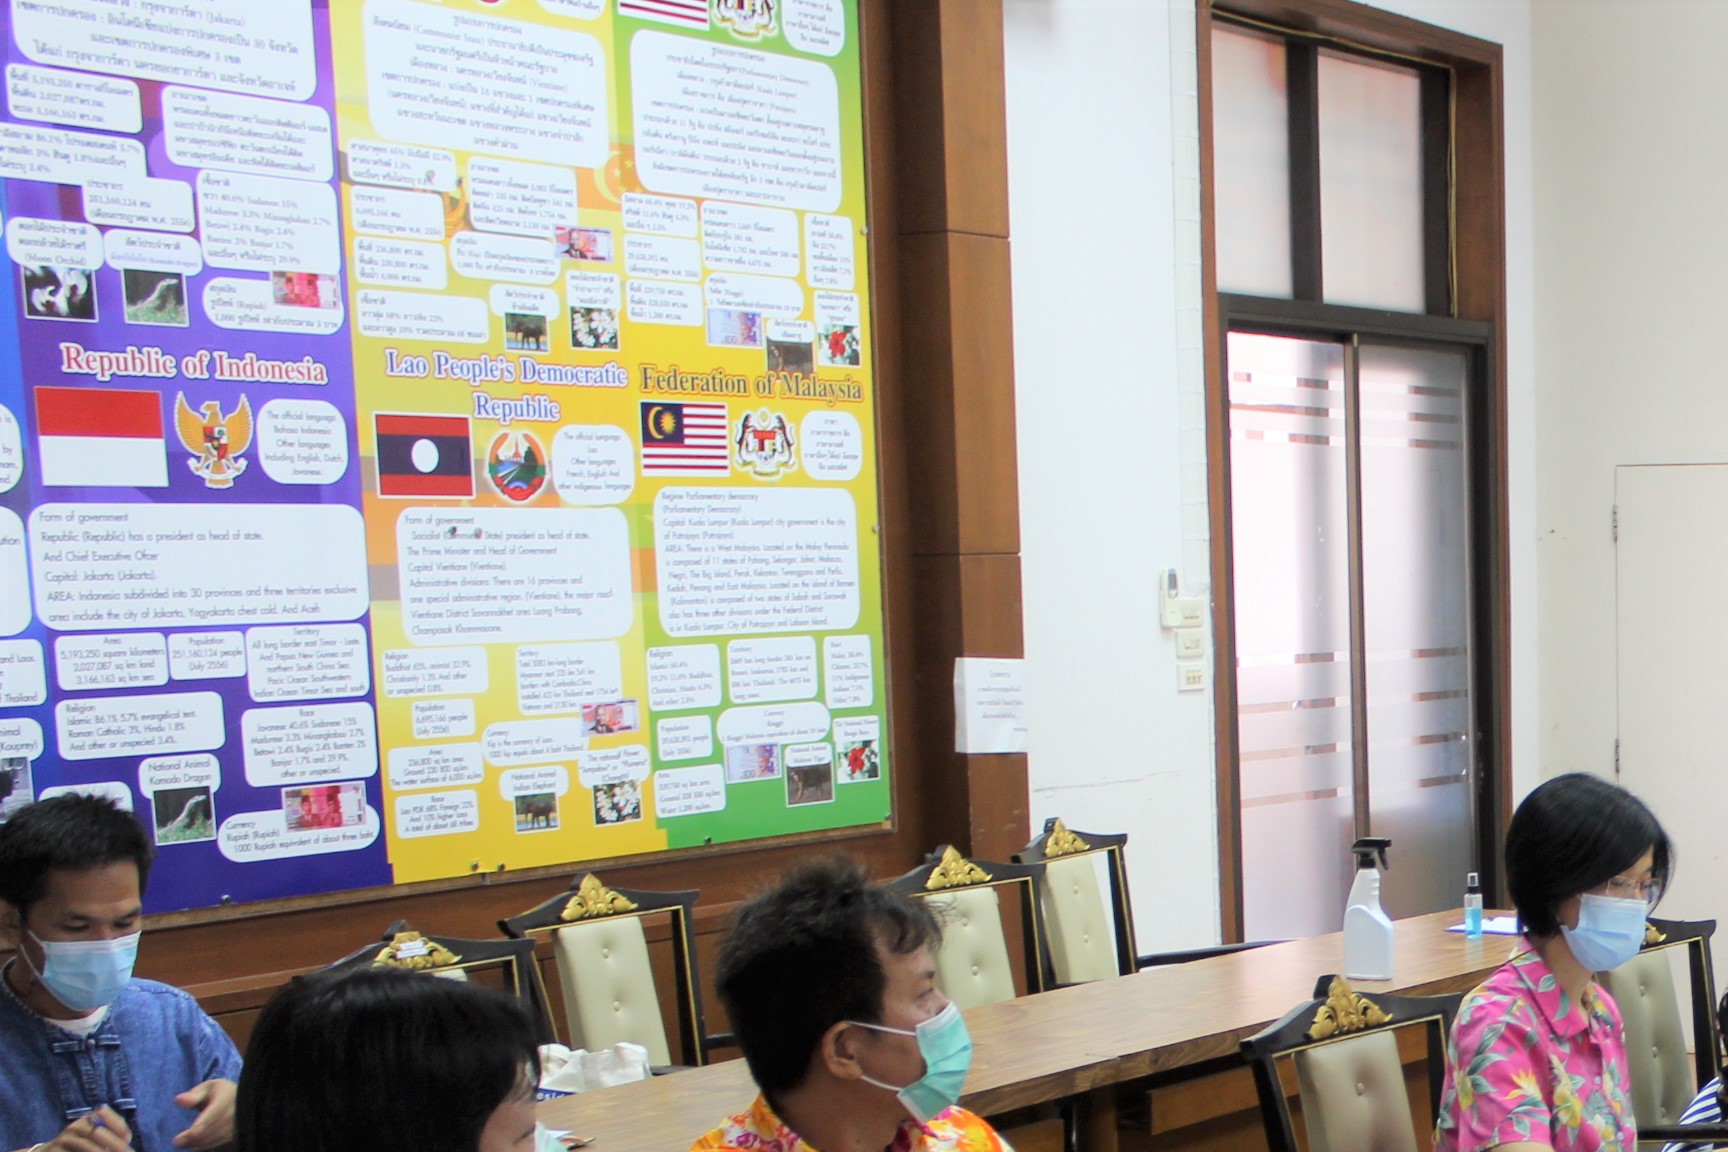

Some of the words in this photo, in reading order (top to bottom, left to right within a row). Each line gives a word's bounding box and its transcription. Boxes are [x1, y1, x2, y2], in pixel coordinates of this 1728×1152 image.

[206, 11, 246, 27] (Jakarta)
[64, 345, 173, 378] Republic
[184, 352, 209, 377] of
[217, 353, 327, 382] Indonesia
[388, 352, 427, 376] Lao
[521, 357, 627, 386] Democratic
[641, 366, 748, 394] Federation
[756, 371, 776, 395] of
[782, 371, 863, 405] Malaysia
[474, 394, 560, 423] Republic
[686, 491, 726, 503] Parliamentary
[40, 512, 62, 521] Form
[65, 512, 75, 521] of
[78, 512, 128, 524] government
[405, 515, 423, 524] Form
[425, 515, 433, 524] of
[435, 515, 474, 527] government
[41, 532, 80, 544] Republic
[82, 531, 126, 544] (Republic)
[129, 531, 144, 541] has
[147, 533, 153, 541] a
[155, 531, 194, 544] president
[209, 531, 230, 540] head
[232, 531, 241, 540] of
[505, 531, 535, 543] president
[547, 531, 564, 540] head
[43, 552, 63, 562] And
[65, 552, 89, 562] Chief
[91, 551, 132, 561] Executive
[406, 547, 419, 556] The
[422, 546, 442, 556] Prime
[444, 546, 471, 555] Minister
[472, 546, 486, 555] and
[488, 546, 506, 555] Head
[518, 546, 557, 555] Government
[436, 562, 468, 571] Vientiane
[83, 571, 115, 581] Jakarta
[409, 577, 458, 587] Administrative
[79, 590, 121, 600] Indonesia
[123, 589, 169, 599] subdivided
[172, 588, 187, 598] into
[190, 588, 202, 598] 30
[204, 587, 243, 600] provinces
[245, 586, 261, 596] and
[264, 586, 283, 596] three
[286, 585, 322, 595] territories
[324, 584, 358, 594] exclusive
[48, 614, 69, 622] area
[72, 610, 104, 621] include
[107, 610, 120, 620] the
[122, 609, 138, 622] city
[140, 609, 150, 619] of
[188, 606, 236, 620] Yogyakarta
[281, 604, 298, 614] And
[301, 604, 321, 614] Aceh
